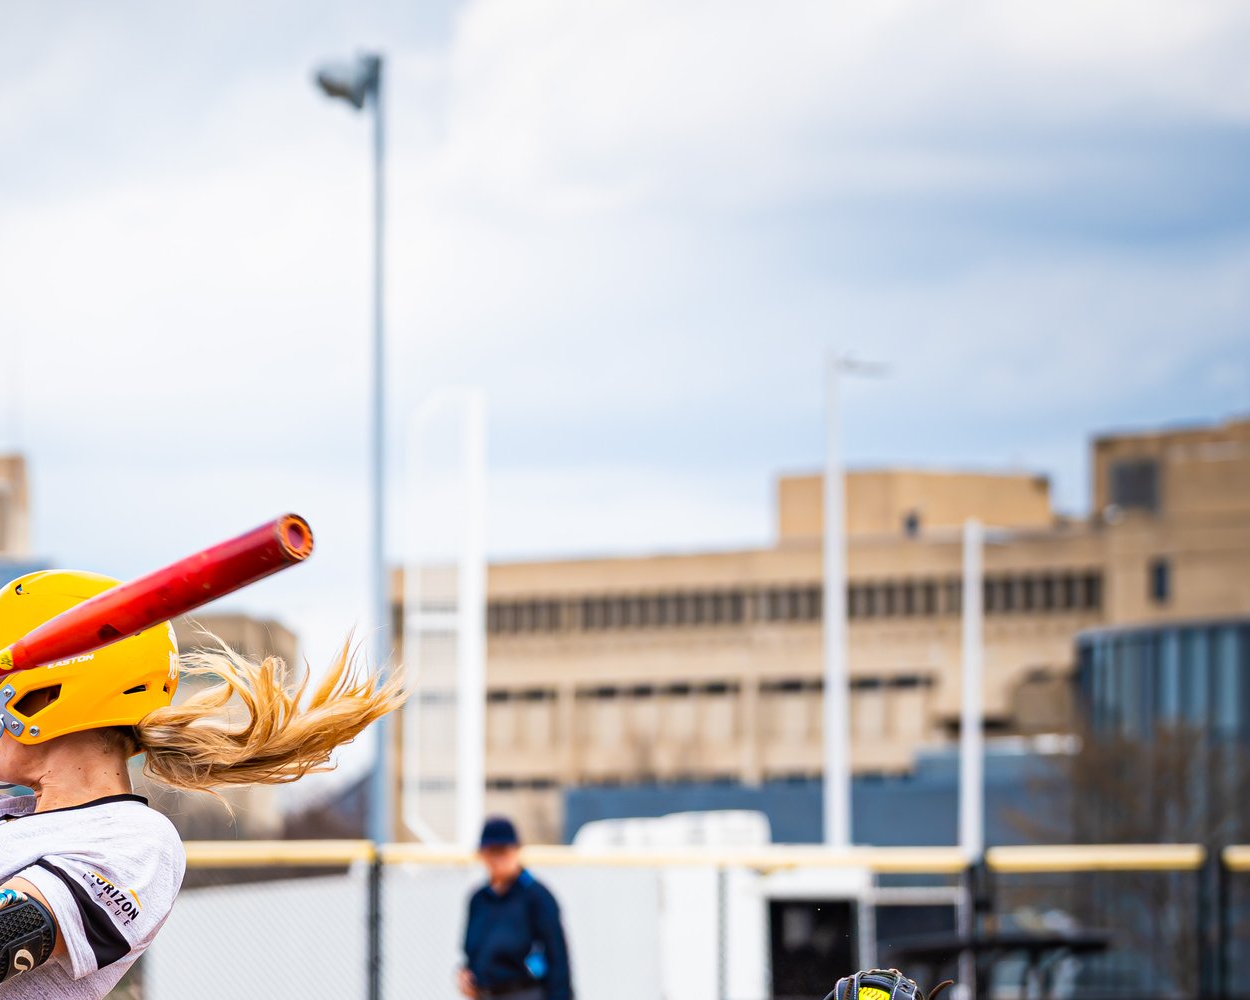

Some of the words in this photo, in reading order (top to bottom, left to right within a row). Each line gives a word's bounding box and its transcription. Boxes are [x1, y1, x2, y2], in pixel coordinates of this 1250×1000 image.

[47, 654, 94, 669] EASTON
[82, 873, 131, 927] LEAGUE
[88, 871, 139, 920] ORIZON
